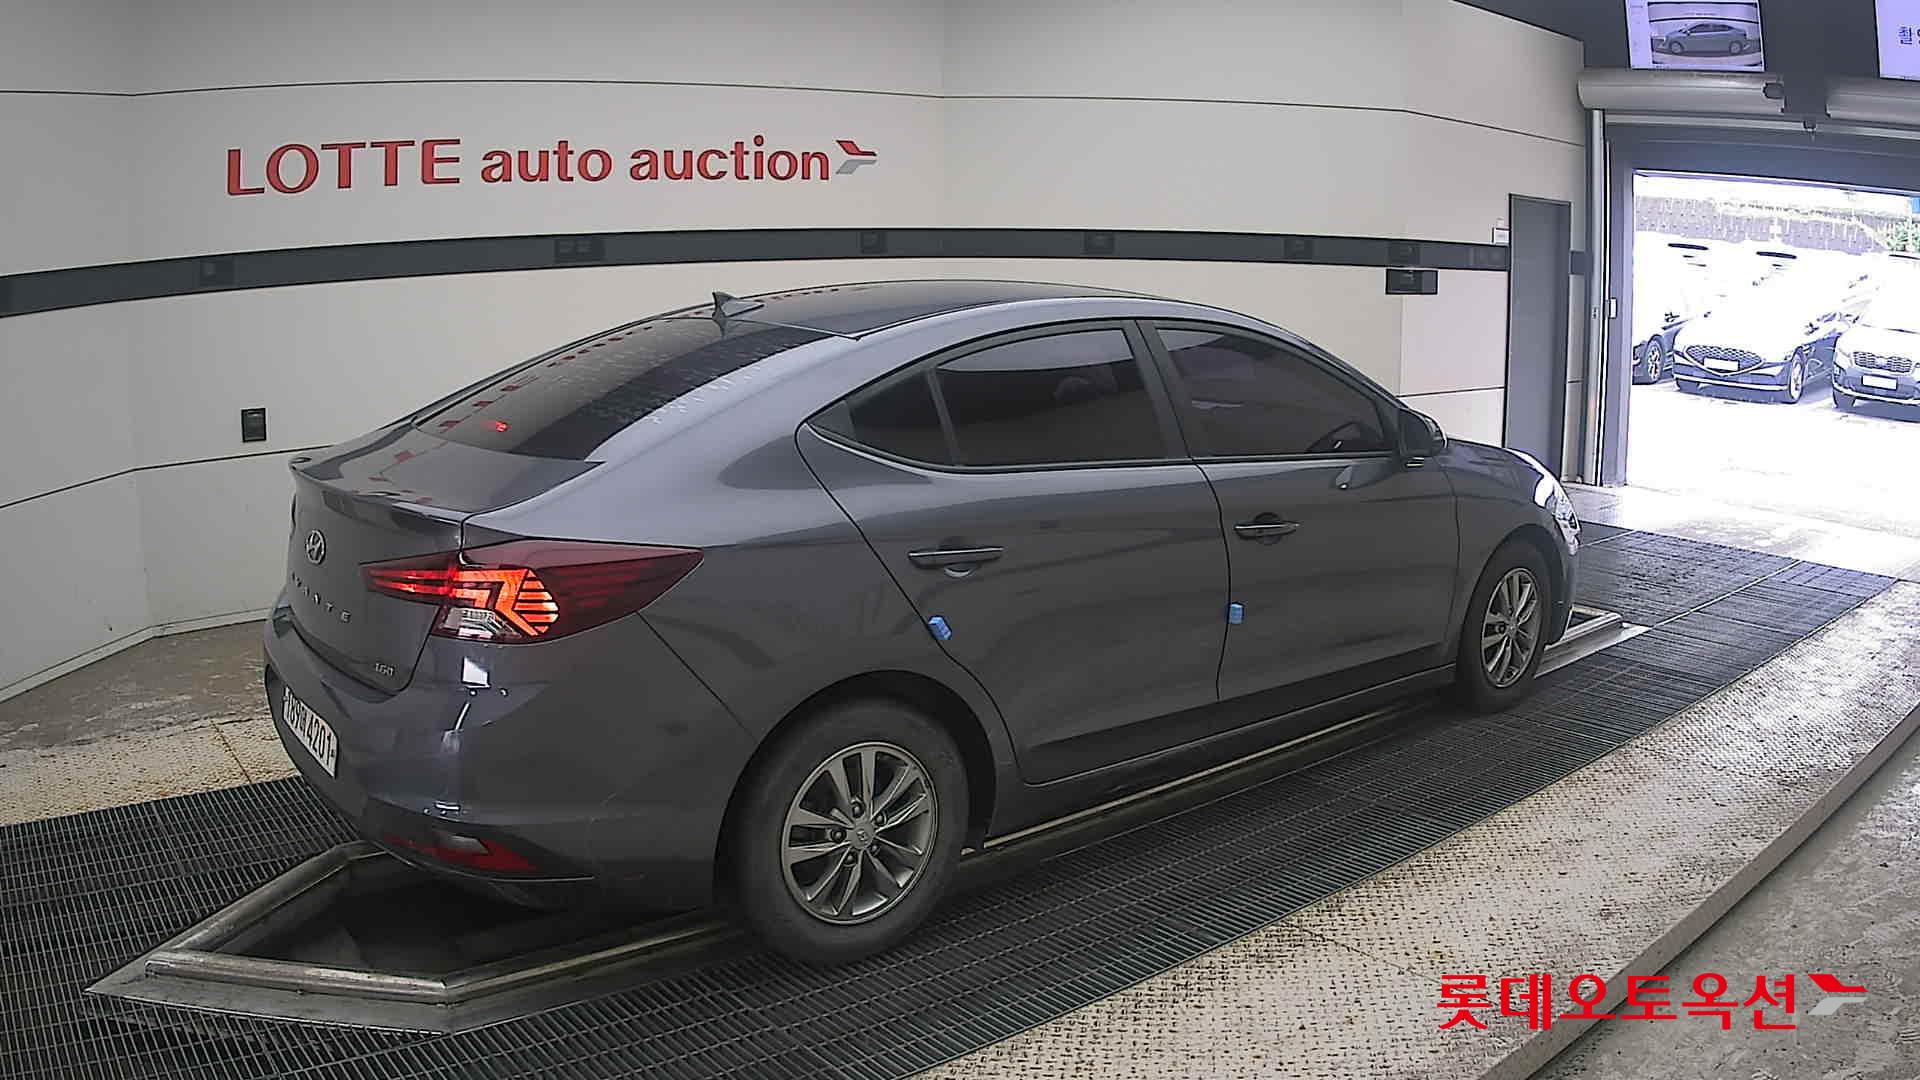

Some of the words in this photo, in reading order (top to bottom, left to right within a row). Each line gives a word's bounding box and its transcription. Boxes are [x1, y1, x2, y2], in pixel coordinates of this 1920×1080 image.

[227, 138, 461, 196] LOTTE
[480, 140, 614, 183] auto
[629, 135, 830, 183] auction
